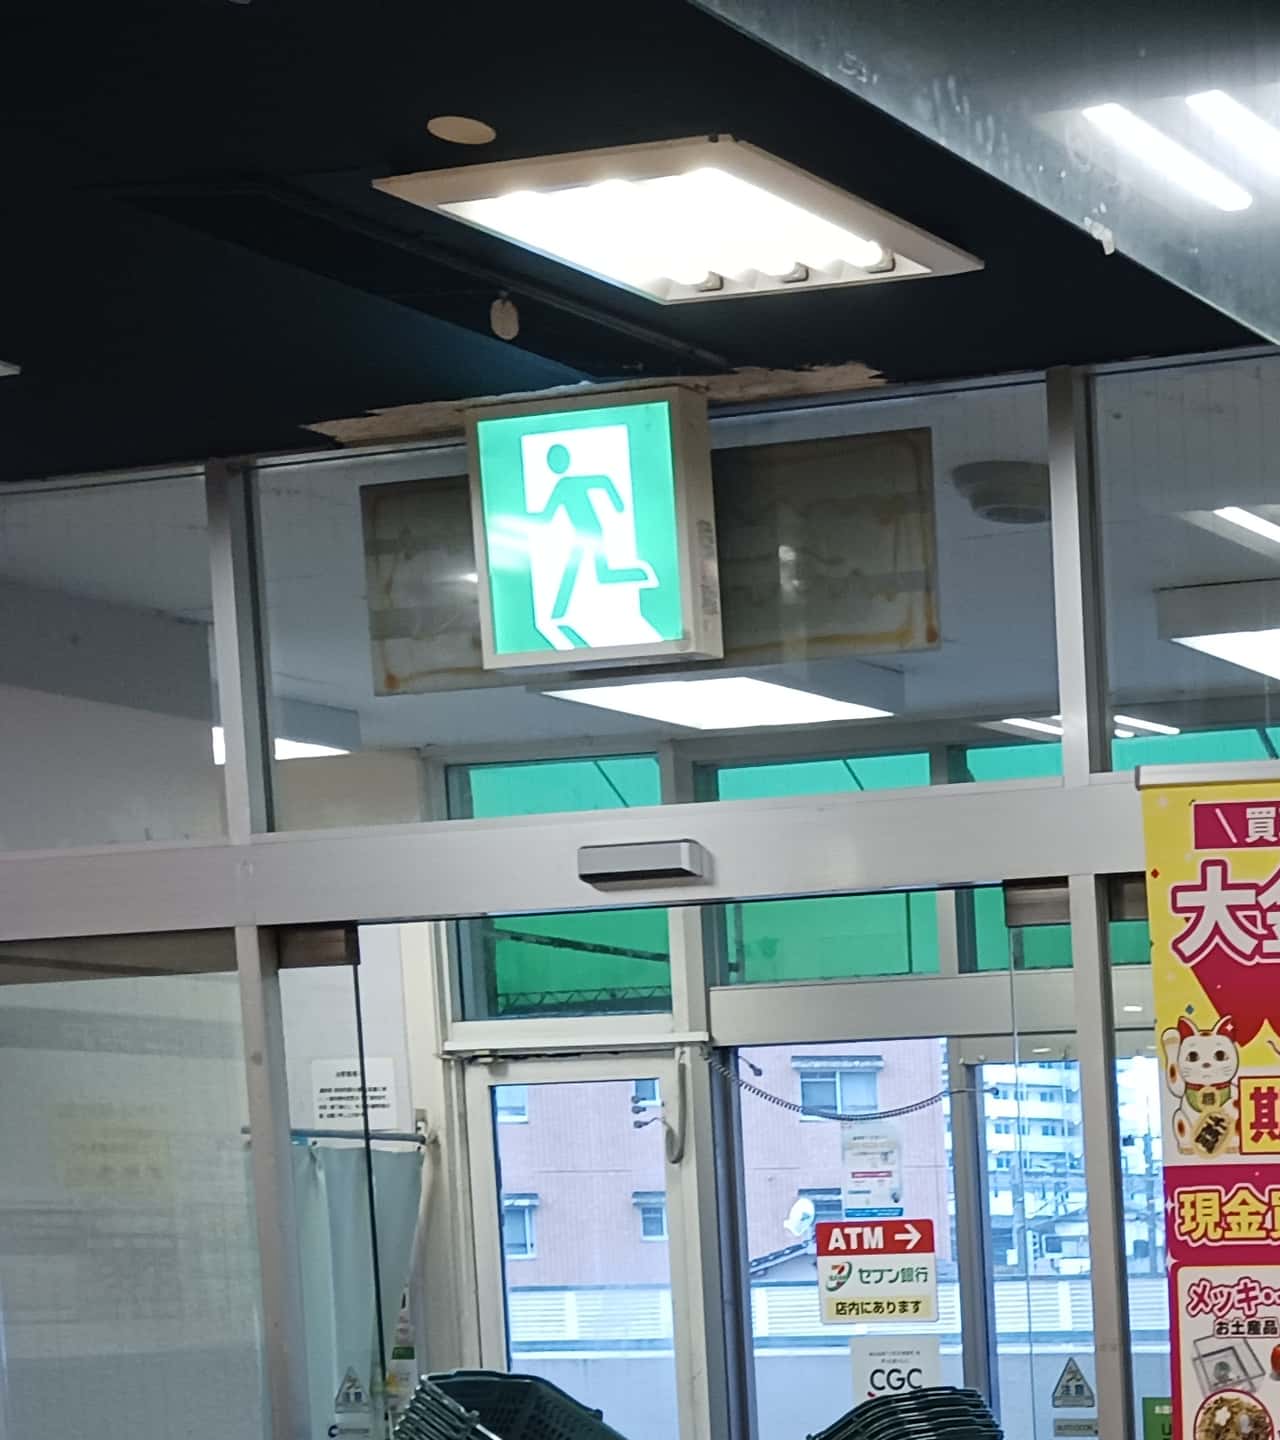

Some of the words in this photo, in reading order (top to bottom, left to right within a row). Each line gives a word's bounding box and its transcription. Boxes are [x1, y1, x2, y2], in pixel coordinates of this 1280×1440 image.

[828, 1226, 884, 1251] ATM
[858, 1267, 928, 1284] セブン銀行
[835, 1301, 922, 1315] 店内にあります
[870, 1368, 922, 1391] CGC
